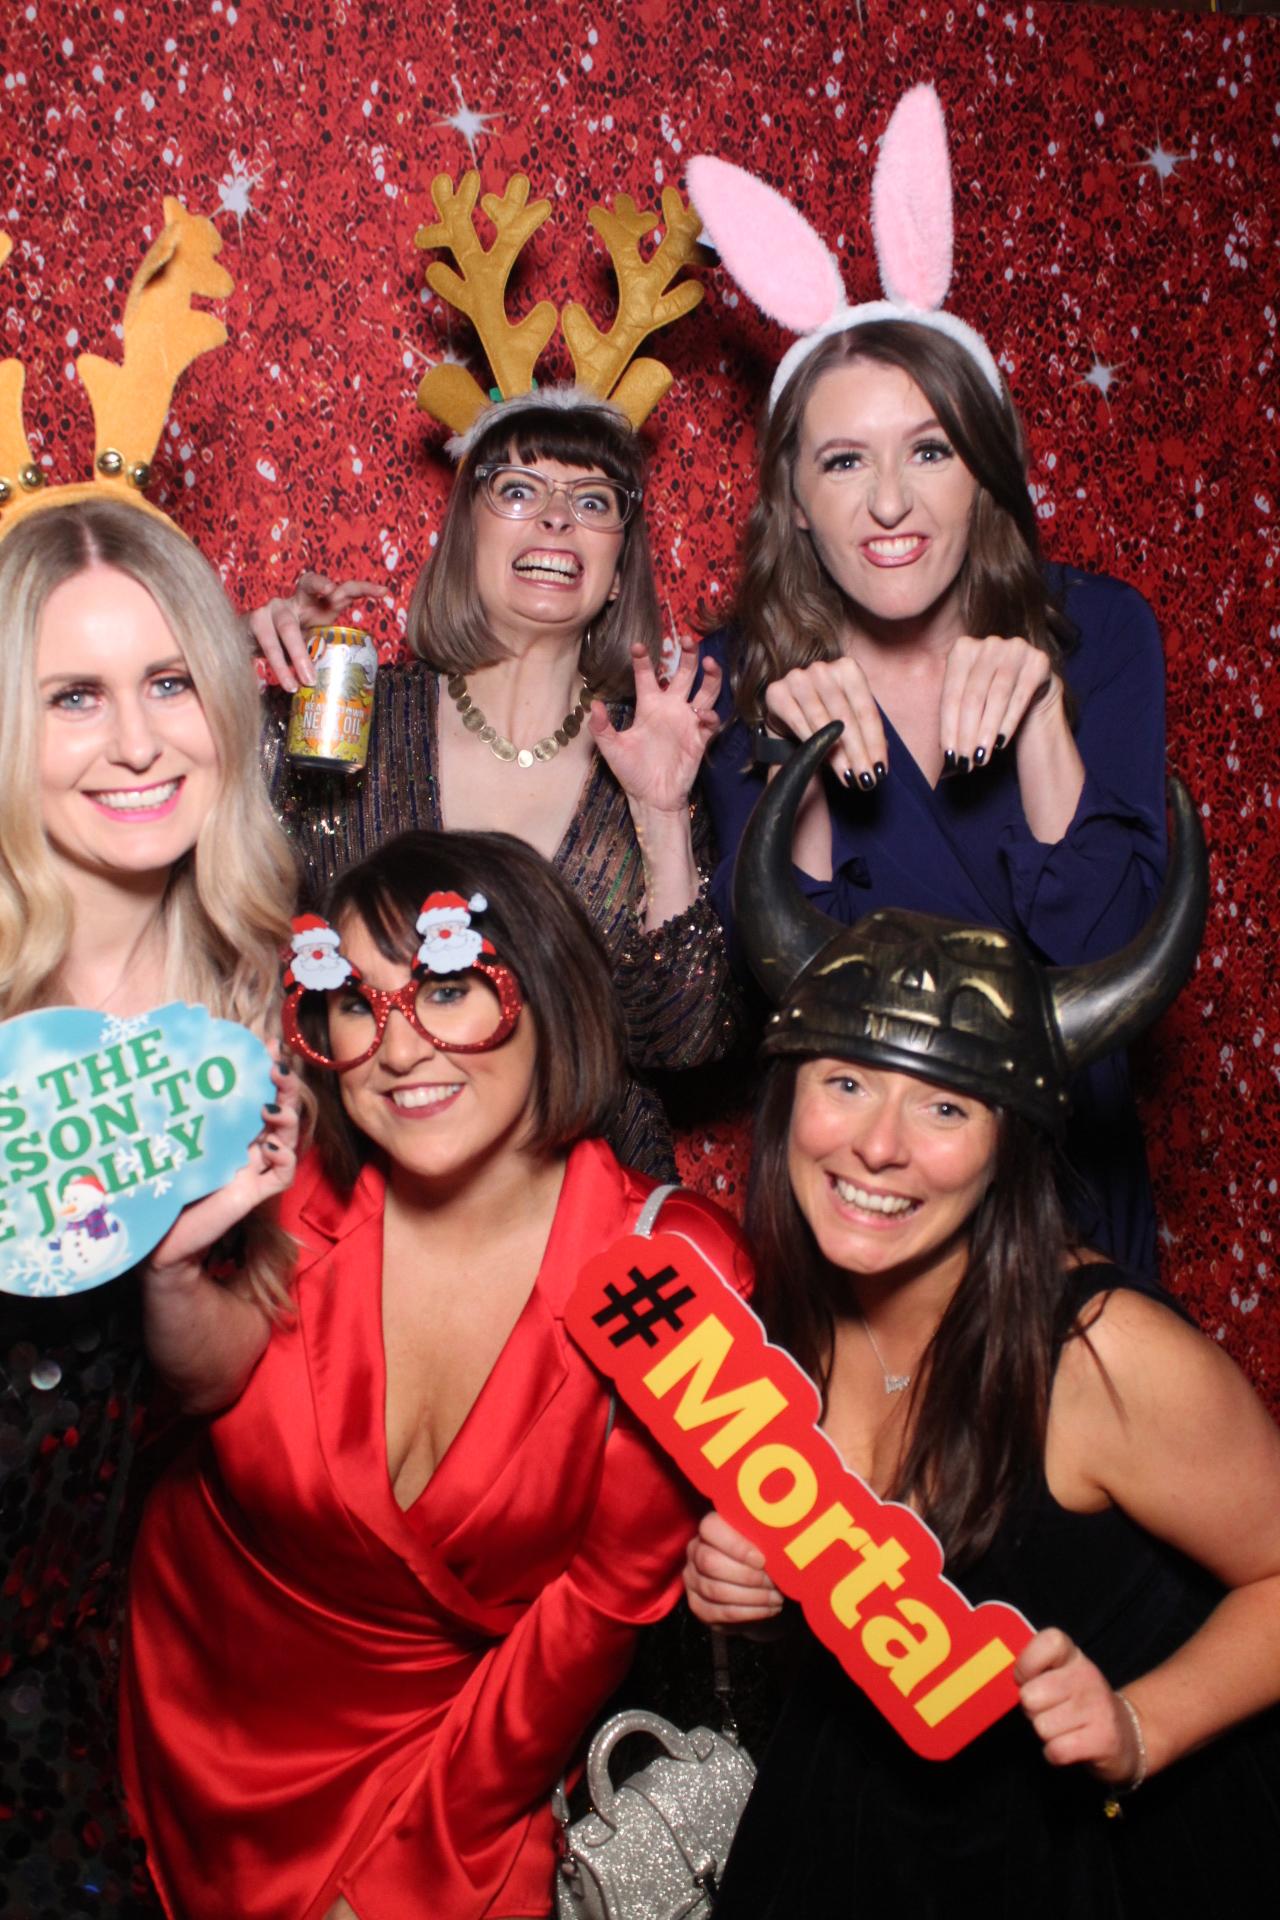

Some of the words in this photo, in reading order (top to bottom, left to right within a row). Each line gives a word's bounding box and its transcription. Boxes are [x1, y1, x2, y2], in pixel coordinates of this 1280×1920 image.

[343, 716, 361, 736] OIL
[0, 1092, 140, 1188] SON
[152, 1056, 236, 1117] TO
[37, 1029, 170, 1111] THE
[591, 1264, 1016, 1729] #Mortal
